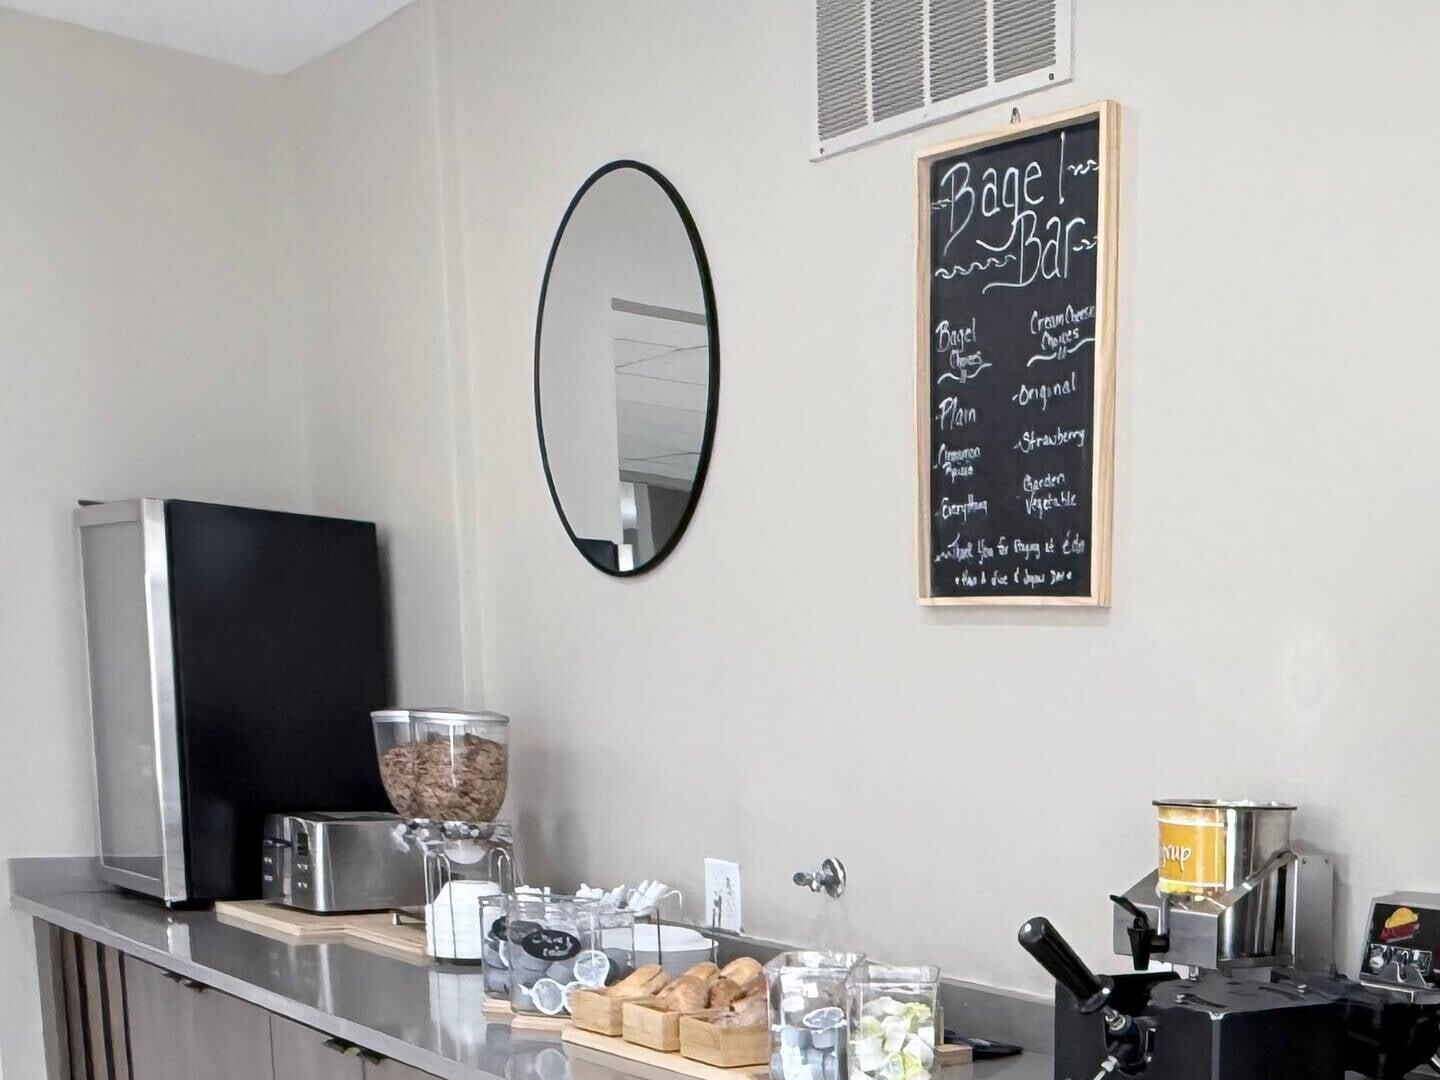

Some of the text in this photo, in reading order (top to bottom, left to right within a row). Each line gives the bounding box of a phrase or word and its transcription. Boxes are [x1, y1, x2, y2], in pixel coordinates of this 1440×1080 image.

[940, 131, 1065, 256] Bagel
[982, 210, 1086, 293] Bar
[935, 317, 976, 353] Bagel
[1031, 310, 1064, 334] Cream
[1041, 328, 1080, 350] Choices
